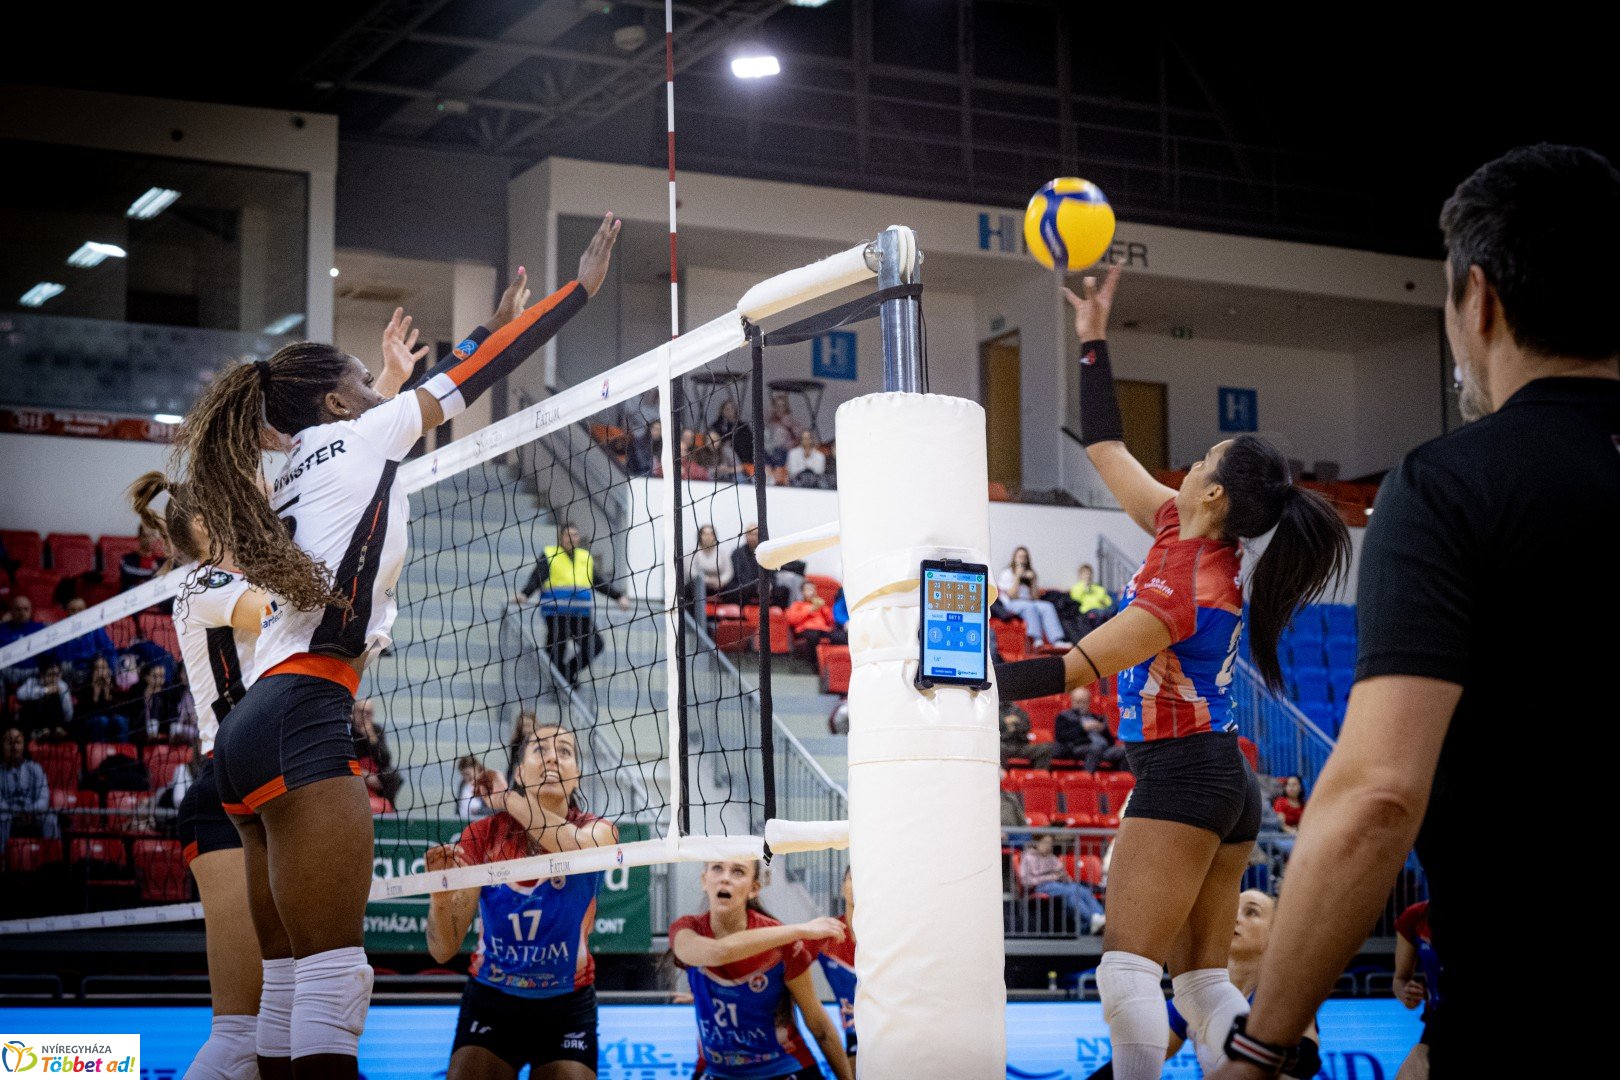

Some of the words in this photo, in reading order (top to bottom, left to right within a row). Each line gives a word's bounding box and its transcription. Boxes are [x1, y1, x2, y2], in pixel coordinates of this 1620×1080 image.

[508, 909, 542, 941] 17
[491, 935, 569, 962] FATUM
[712, 998, 739, 1028] 21
